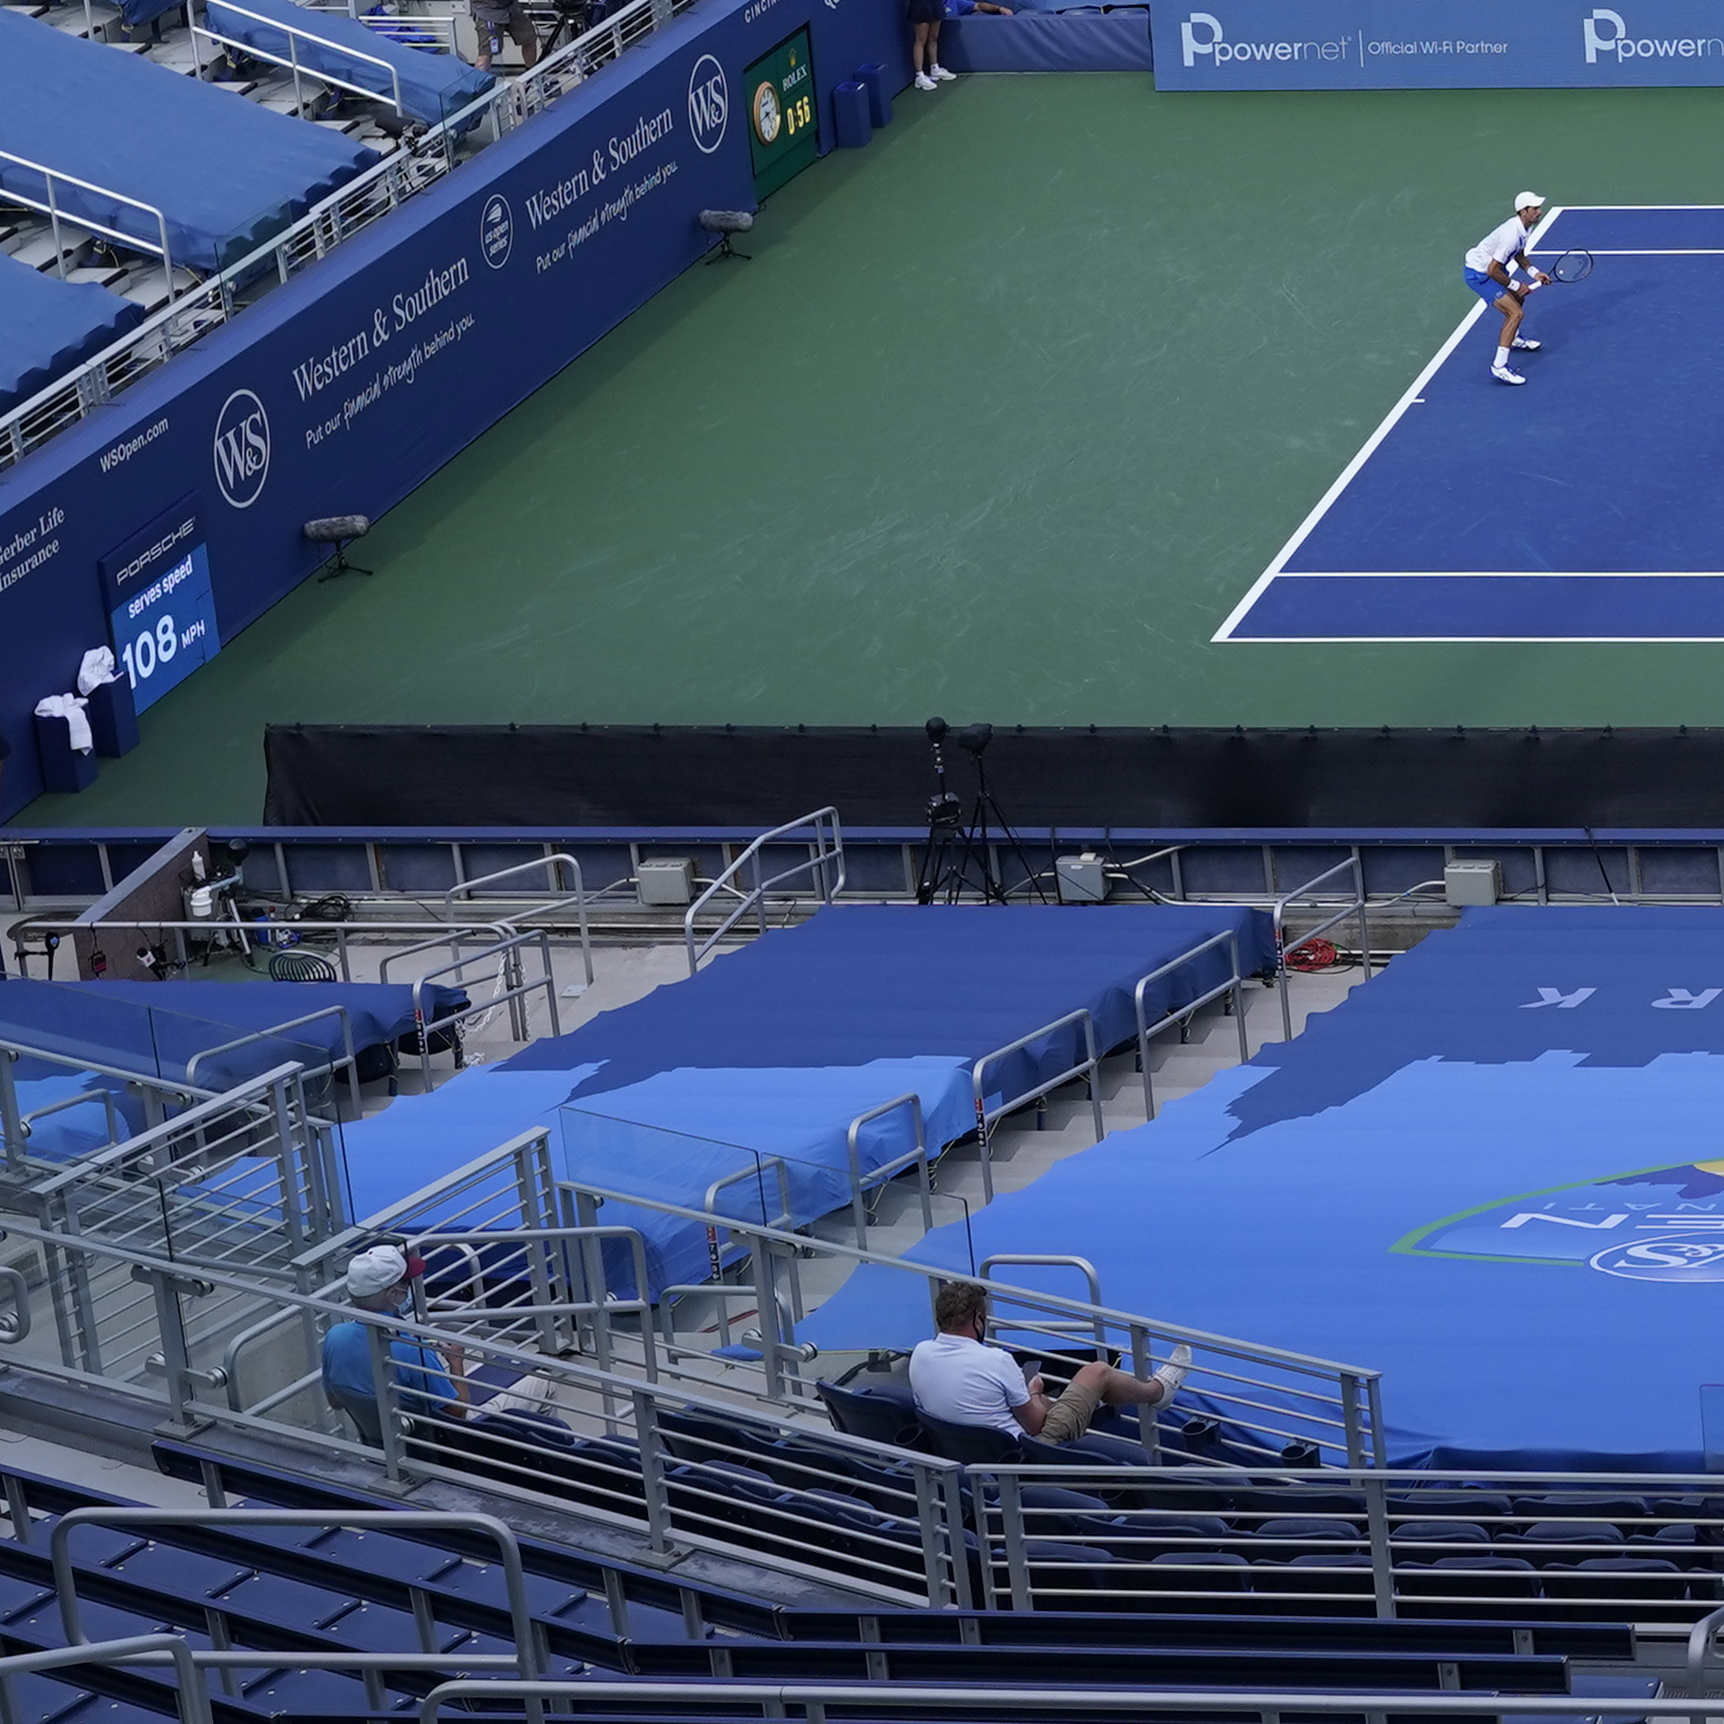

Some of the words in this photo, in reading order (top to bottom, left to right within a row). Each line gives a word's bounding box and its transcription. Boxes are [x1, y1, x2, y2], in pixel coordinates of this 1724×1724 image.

[782, 63, 808, 92] ROLEX
[1214, 37, 1348, 67] powernet
[1368, 42, 1417, 55] Official
[1420, 41, 1453, 53] Wi-Fi
[1457, 41, 1508, 53] Partner
[690, 74, 726, 137] W&S
[786, 96, 811, 135] 0:56
[525, 169, 590, 231] Western
[592, 149, 607, 186] &
[608, 108, 674, 172] Southern
[489, 235, 508, 257] series
[493, 220, 509, 241] open
[535, 253, 551, 274] Put
[552, 241, 567, 262] our
[635, 165, 661, 198] behind
[292, 331, 369, 403] Western
[373, 308, 391, 348] &
[392, 257, 470, 332] Southern
[305, 427, 324, 450] Put
[325, 411, 343, 434] our
[343, 373, 382, 430] financial
[424, 321, 456, 360] behind
[100, 418, 169, 473] WSOpen.com
[217, 410, 267, 490] W&S
[39, 507, 65, 536] Life
[116, 517, 195, 586] PORSCHE
[128, 581, 162, 619] serves
[163, 554, 193, 595] speed
[122, 614, 178, 689] 108
[181, 619, 206, 649] MPH
